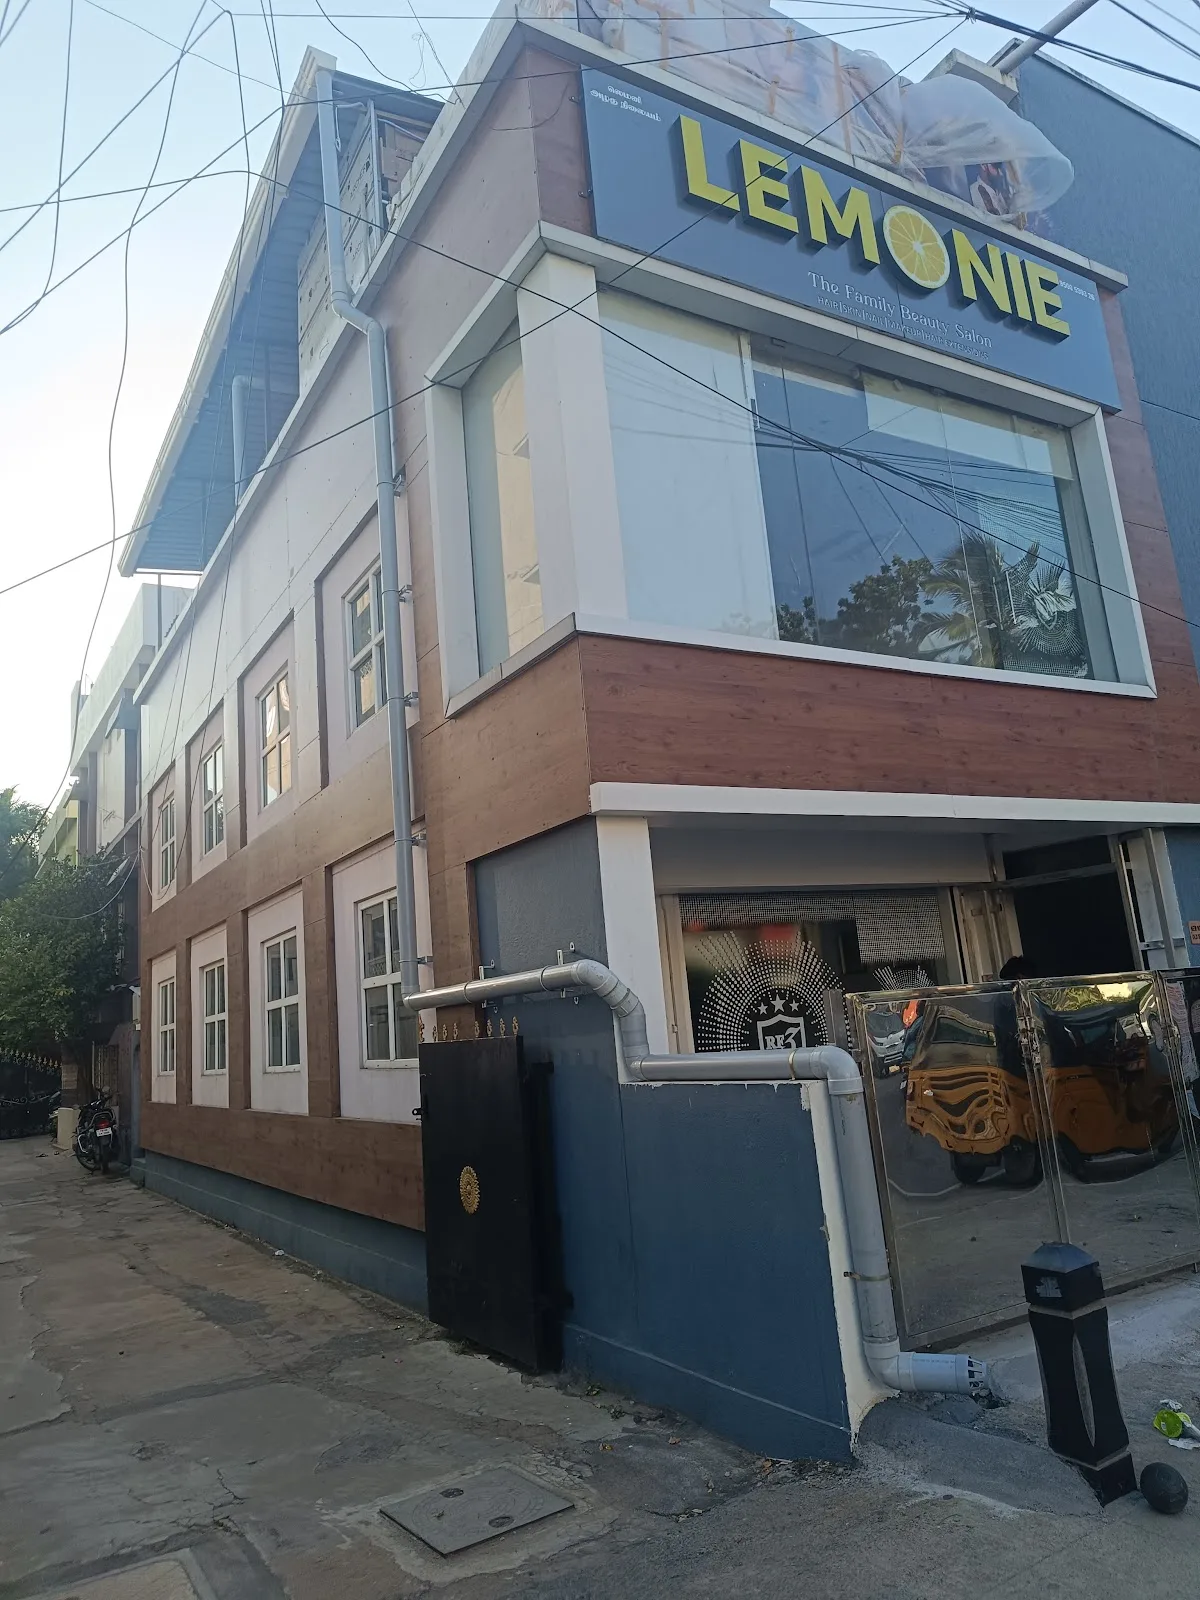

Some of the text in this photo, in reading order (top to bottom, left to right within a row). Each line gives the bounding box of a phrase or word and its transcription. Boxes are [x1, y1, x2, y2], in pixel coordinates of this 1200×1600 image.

[807, 271, 993, 349] The Family Beauty Salon
